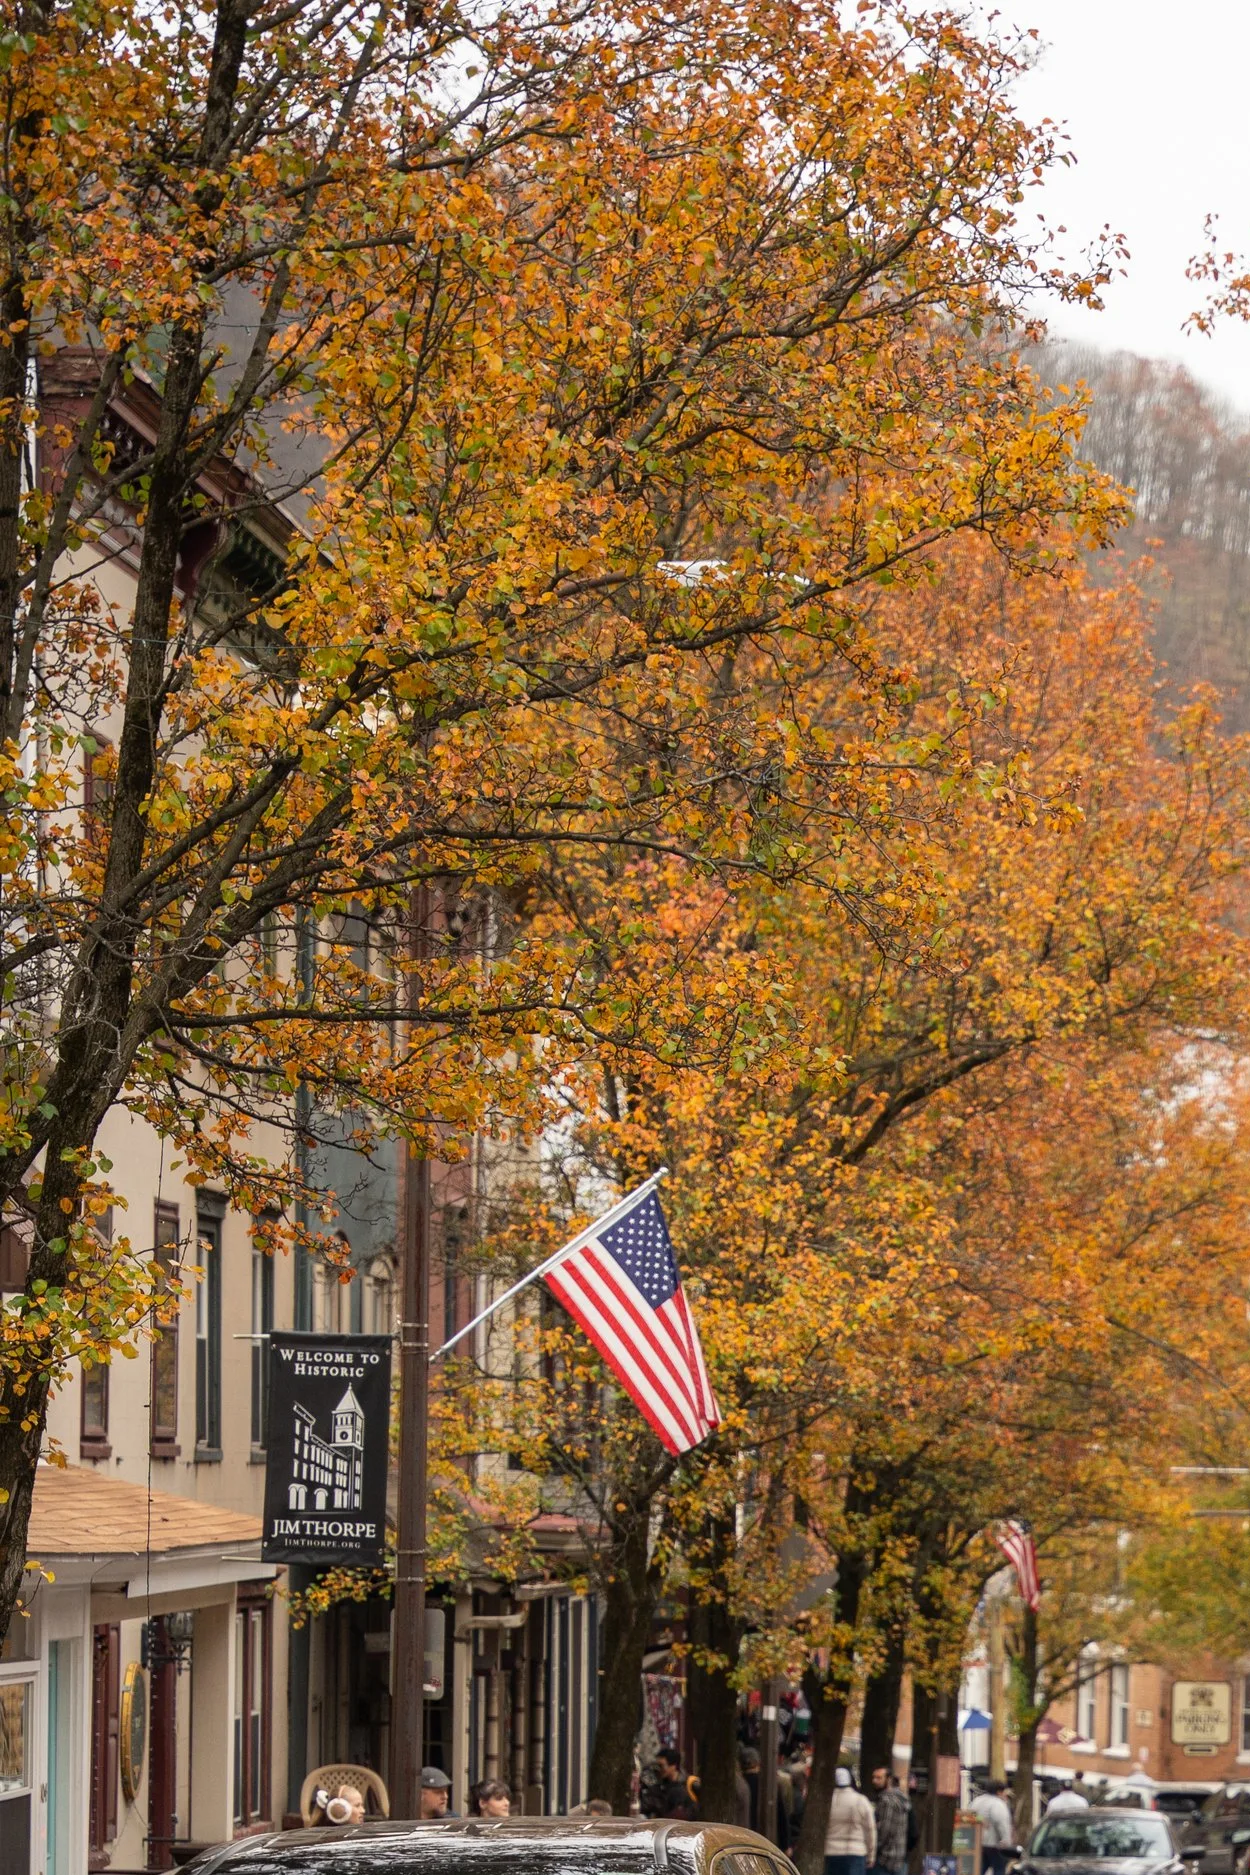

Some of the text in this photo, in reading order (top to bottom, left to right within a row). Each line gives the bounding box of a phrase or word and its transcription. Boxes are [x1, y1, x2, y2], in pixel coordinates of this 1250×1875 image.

[280, 1348, 380, 1364] WELCOME TO
[294, 1363, 364, 1378] HISTORIC
[271, 1519, 376, 1538] JIM THORPE
[284, 1538, 360, 1549] JIMTHORPE.ORG
